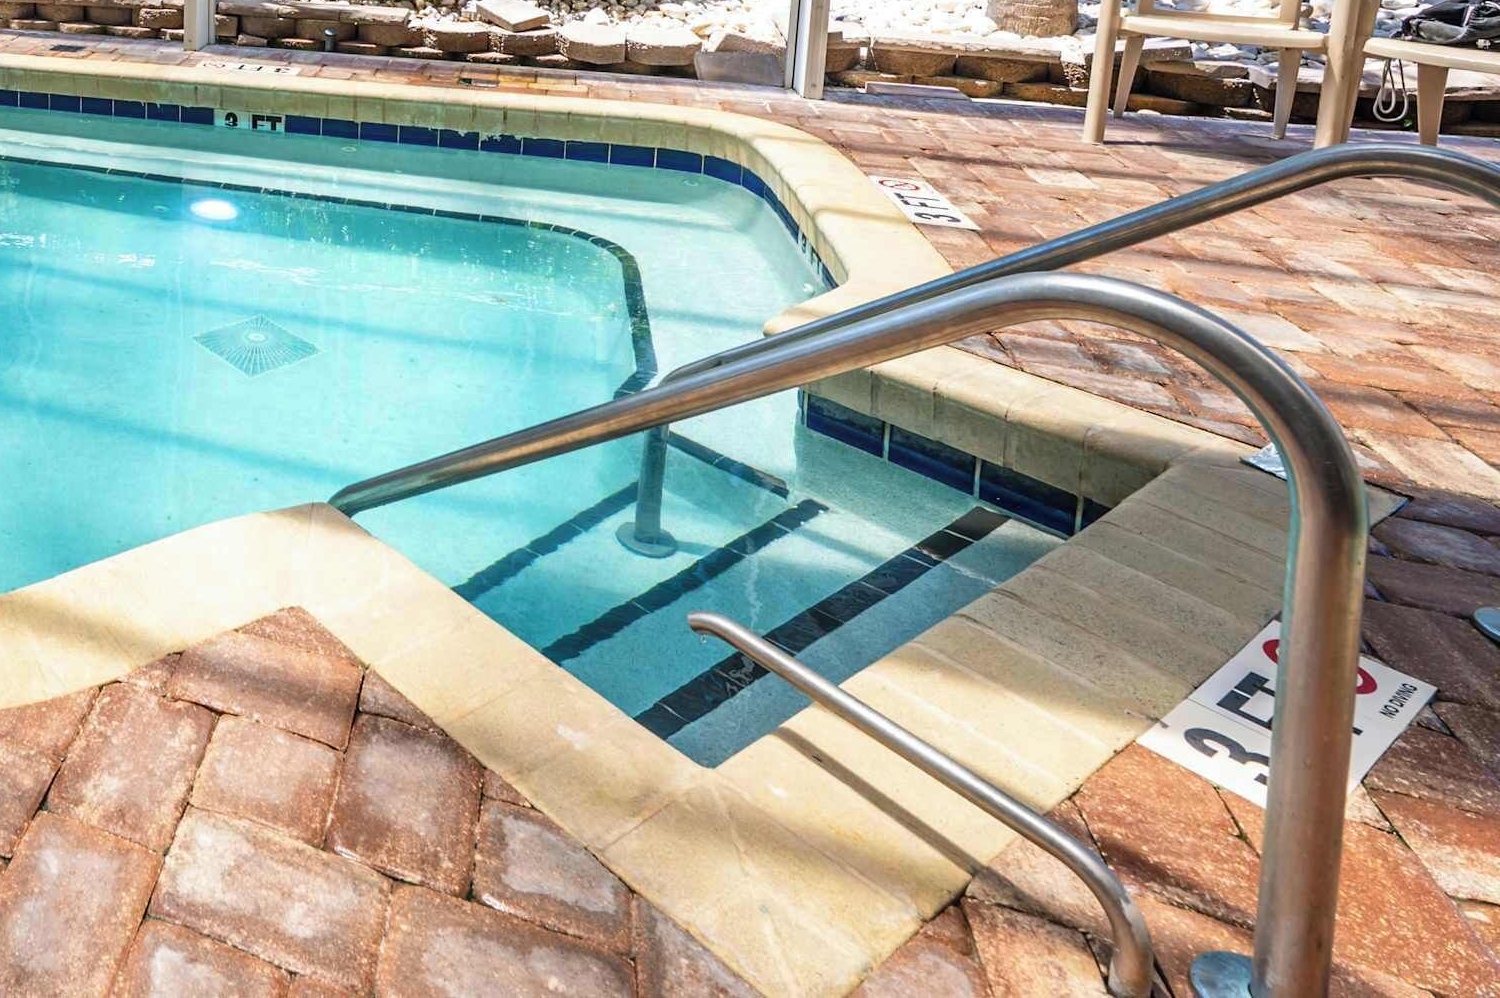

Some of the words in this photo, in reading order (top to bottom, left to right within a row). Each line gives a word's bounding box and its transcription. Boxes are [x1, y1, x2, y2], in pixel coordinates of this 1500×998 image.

[251, 113, 282, 131] FT
[894, 192, 949, 210] FT
[914, 212, 961, 223] 3
[1379, 704, 1399, 719] NO
[1389, 683, 1417, 707] DIVING
